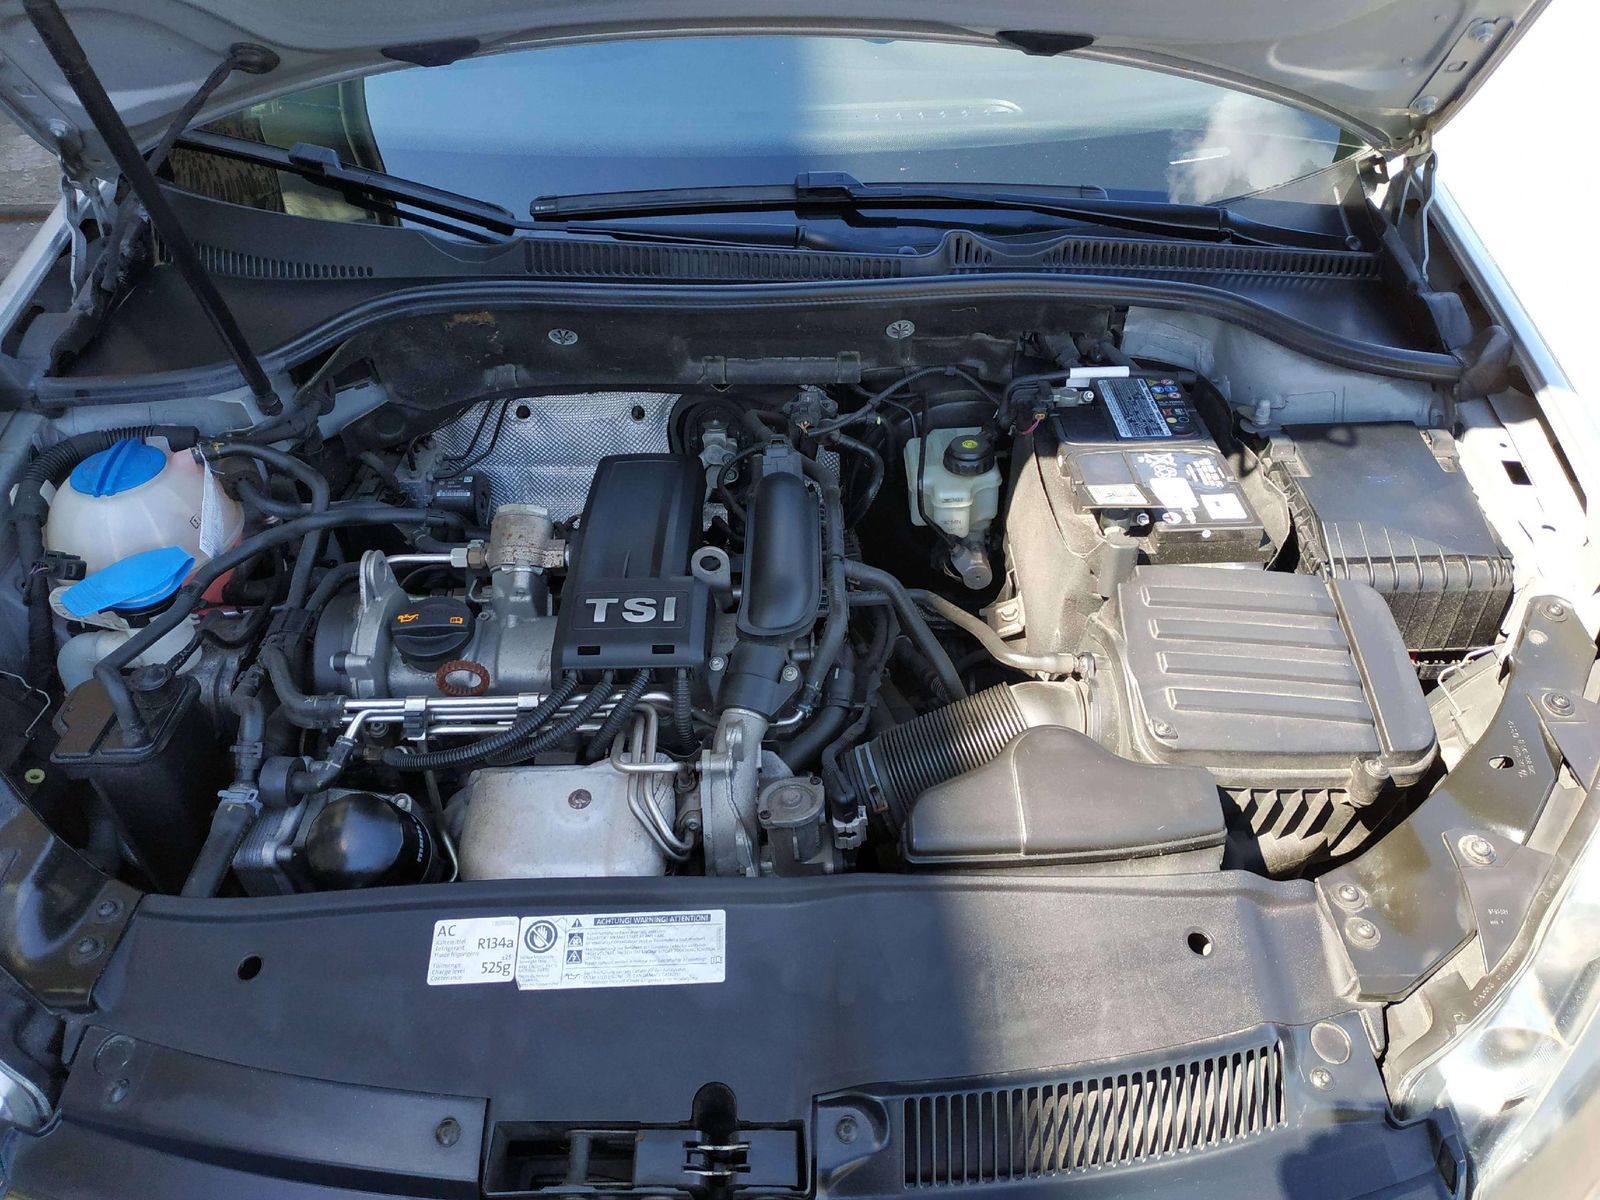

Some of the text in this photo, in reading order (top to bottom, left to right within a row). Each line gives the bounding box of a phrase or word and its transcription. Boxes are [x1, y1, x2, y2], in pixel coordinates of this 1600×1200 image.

[585, 597, 677, 623] TSI
[596, 914, 709, 926] ACHTUNG! WARNING! ATTENTION!
[437, 925, 457, 937] AC
[477, 937, 514, 950] R134a
[481, 961, 511, 977] 525g
